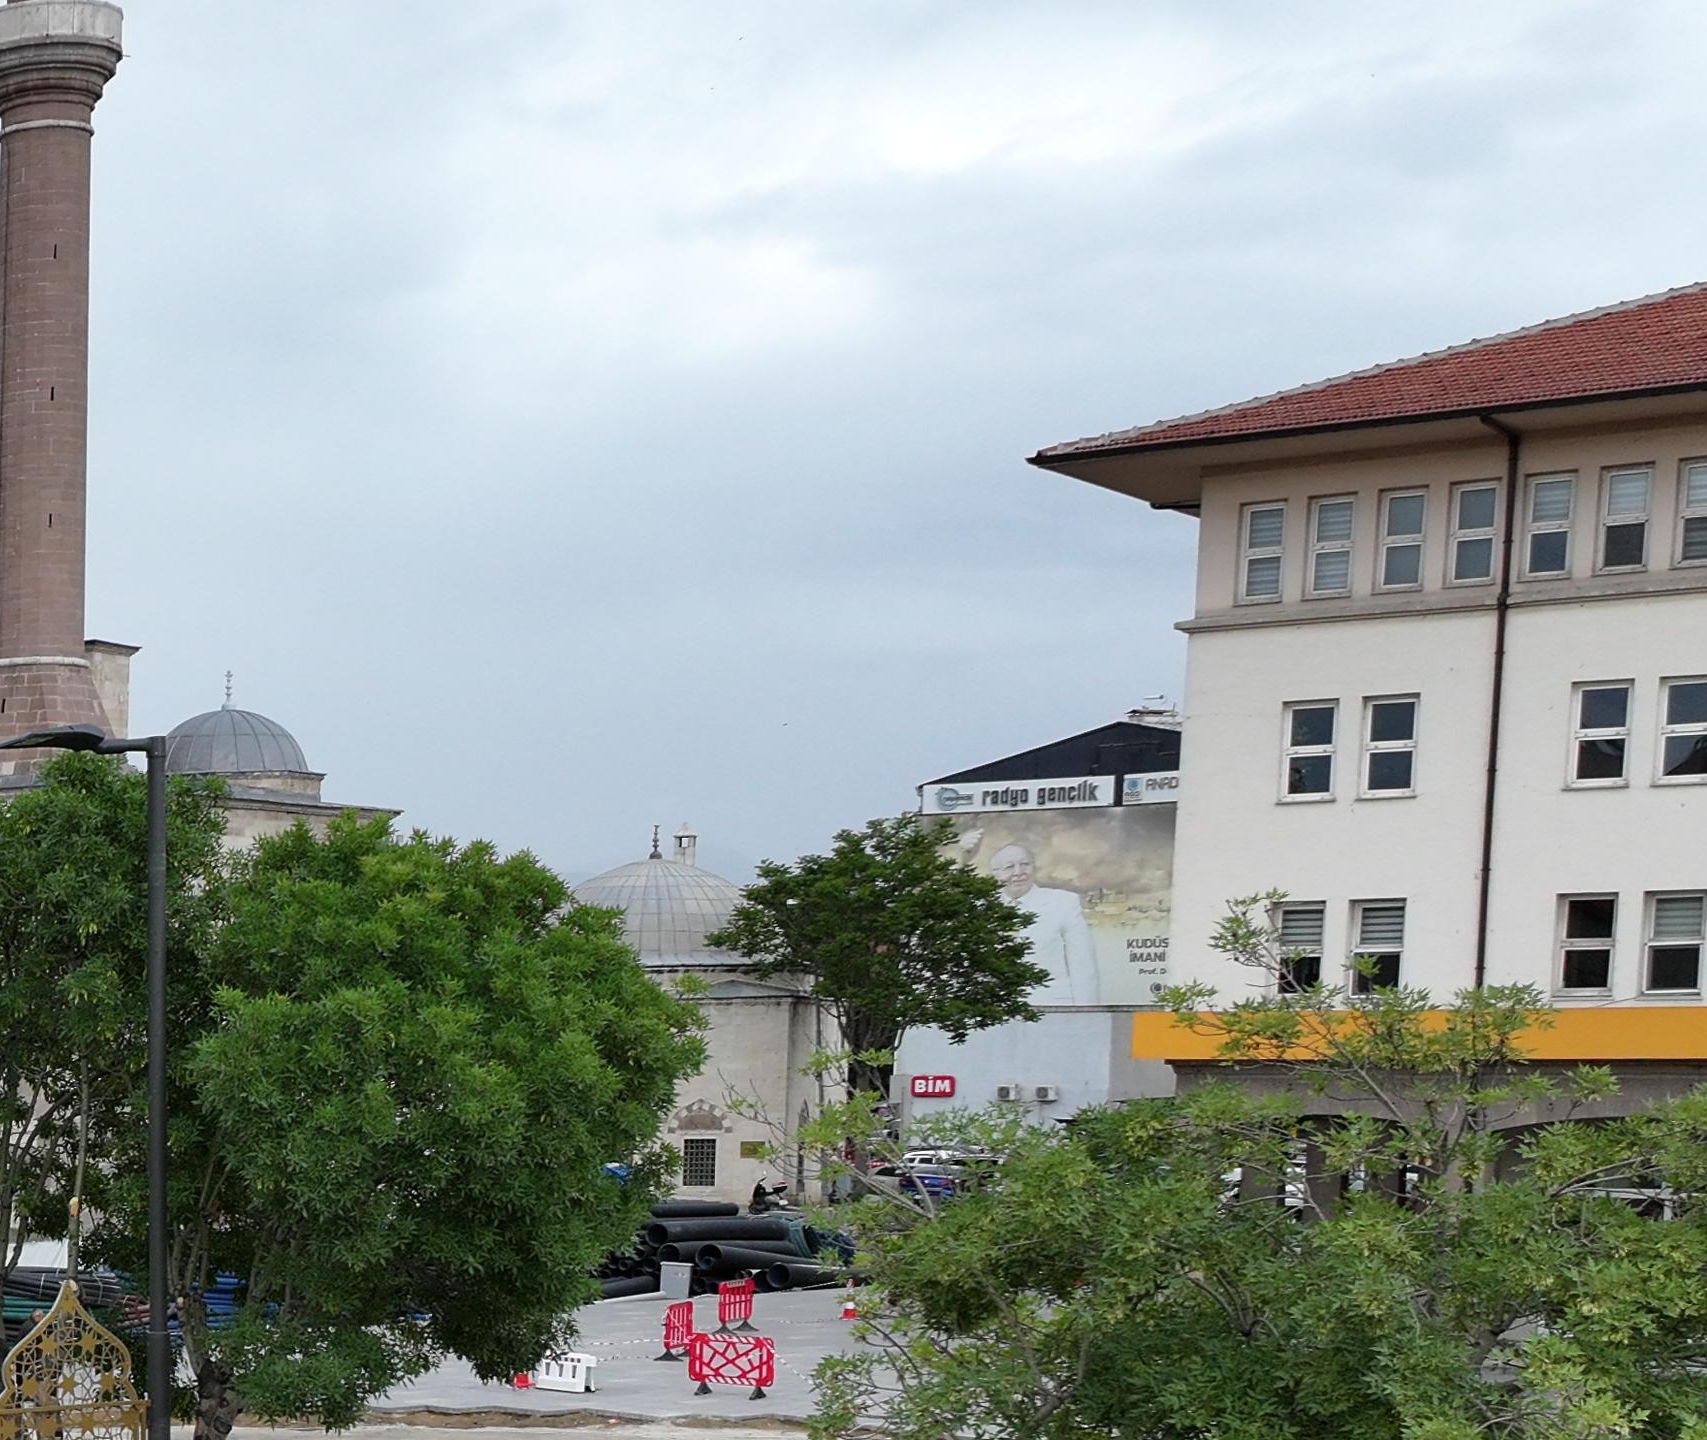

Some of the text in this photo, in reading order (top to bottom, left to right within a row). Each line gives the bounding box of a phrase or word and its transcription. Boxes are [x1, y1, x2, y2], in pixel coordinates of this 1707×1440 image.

[982, 780, 1099, 807] radyo gençlik
[1126, 936, 1169, 949] KUDÜS
[914, 1075, 951, 1093] BİM
